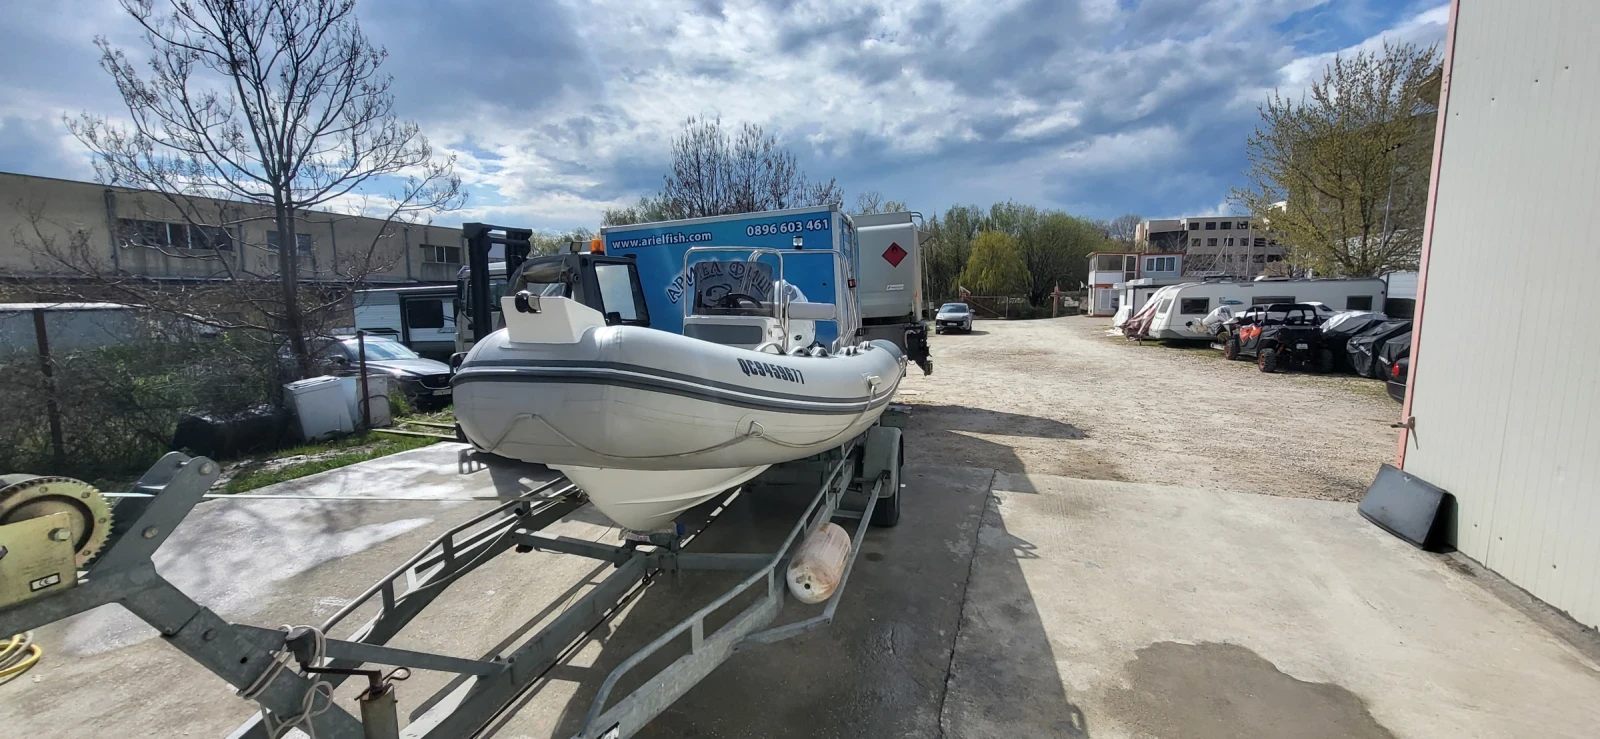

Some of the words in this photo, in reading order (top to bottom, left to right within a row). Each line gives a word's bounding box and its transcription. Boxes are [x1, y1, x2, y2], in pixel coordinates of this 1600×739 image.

[746, 222, 776, 237] 0896
[780, 220, 803, 233] 603
[805, 218, 829, 231] 461
[611, 231, 712, 249] www.arielfish.com
[737, 358, 804, 384] QC9459677
